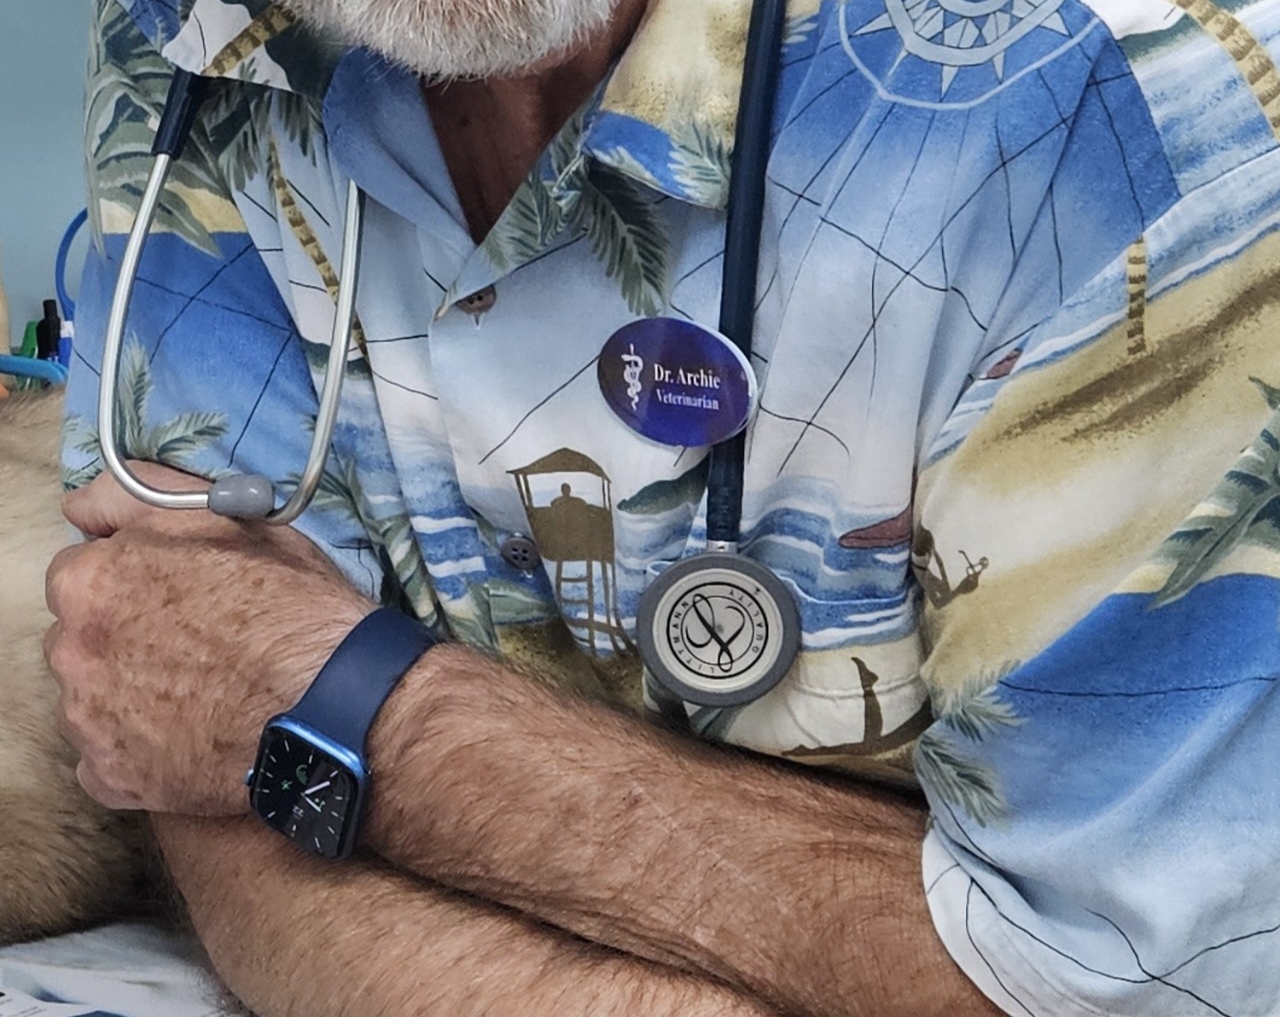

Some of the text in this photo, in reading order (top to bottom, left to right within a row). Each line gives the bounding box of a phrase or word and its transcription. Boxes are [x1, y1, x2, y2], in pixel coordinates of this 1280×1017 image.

[653, 363, 721, 389] Dr. Archie
[656, 389, 720, 411] Veterinarian
